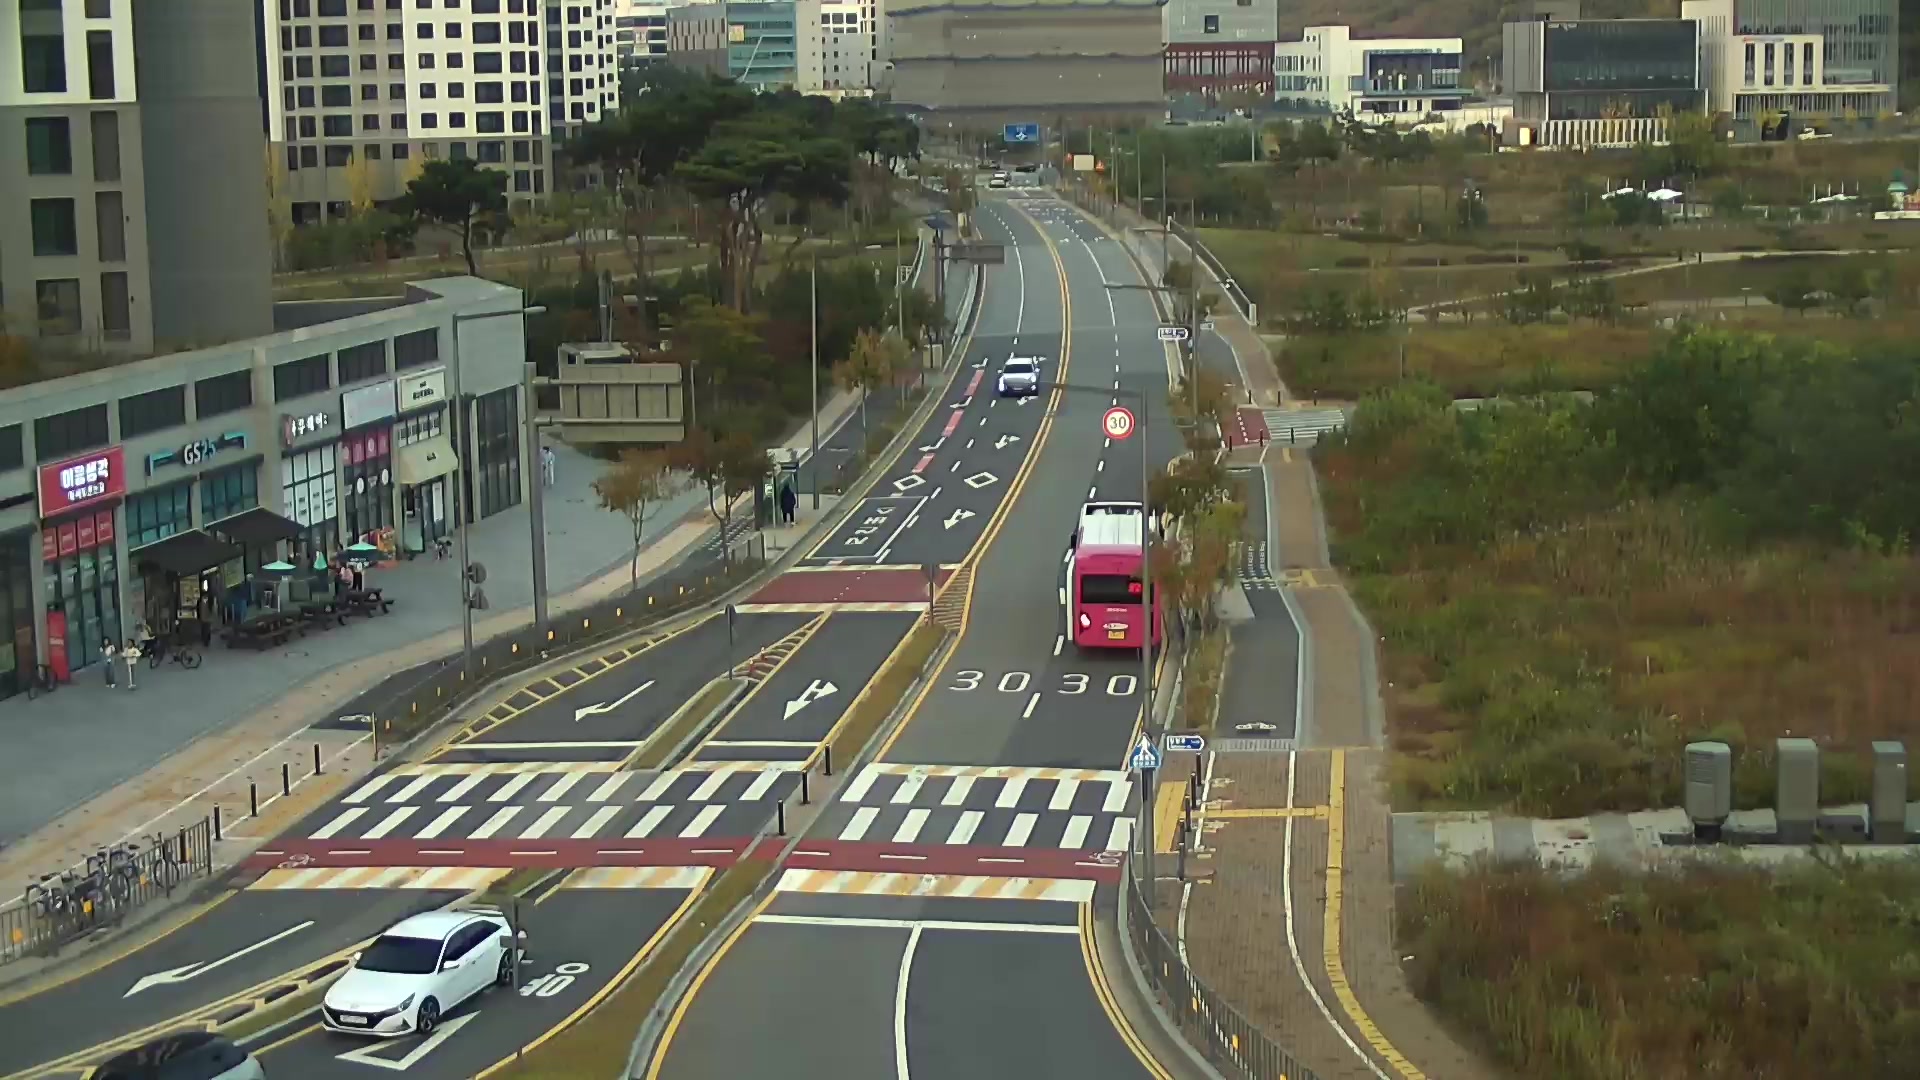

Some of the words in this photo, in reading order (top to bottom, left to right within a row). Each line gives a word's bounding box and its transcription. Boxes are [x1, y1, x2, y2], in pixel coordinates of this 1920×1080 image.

[1109, 416, 1127, 429] 30
[184, 440, 216, 465] GS25
[949, 670, 1031, 693] 30
[1057, 673, 1138, 696] 30
